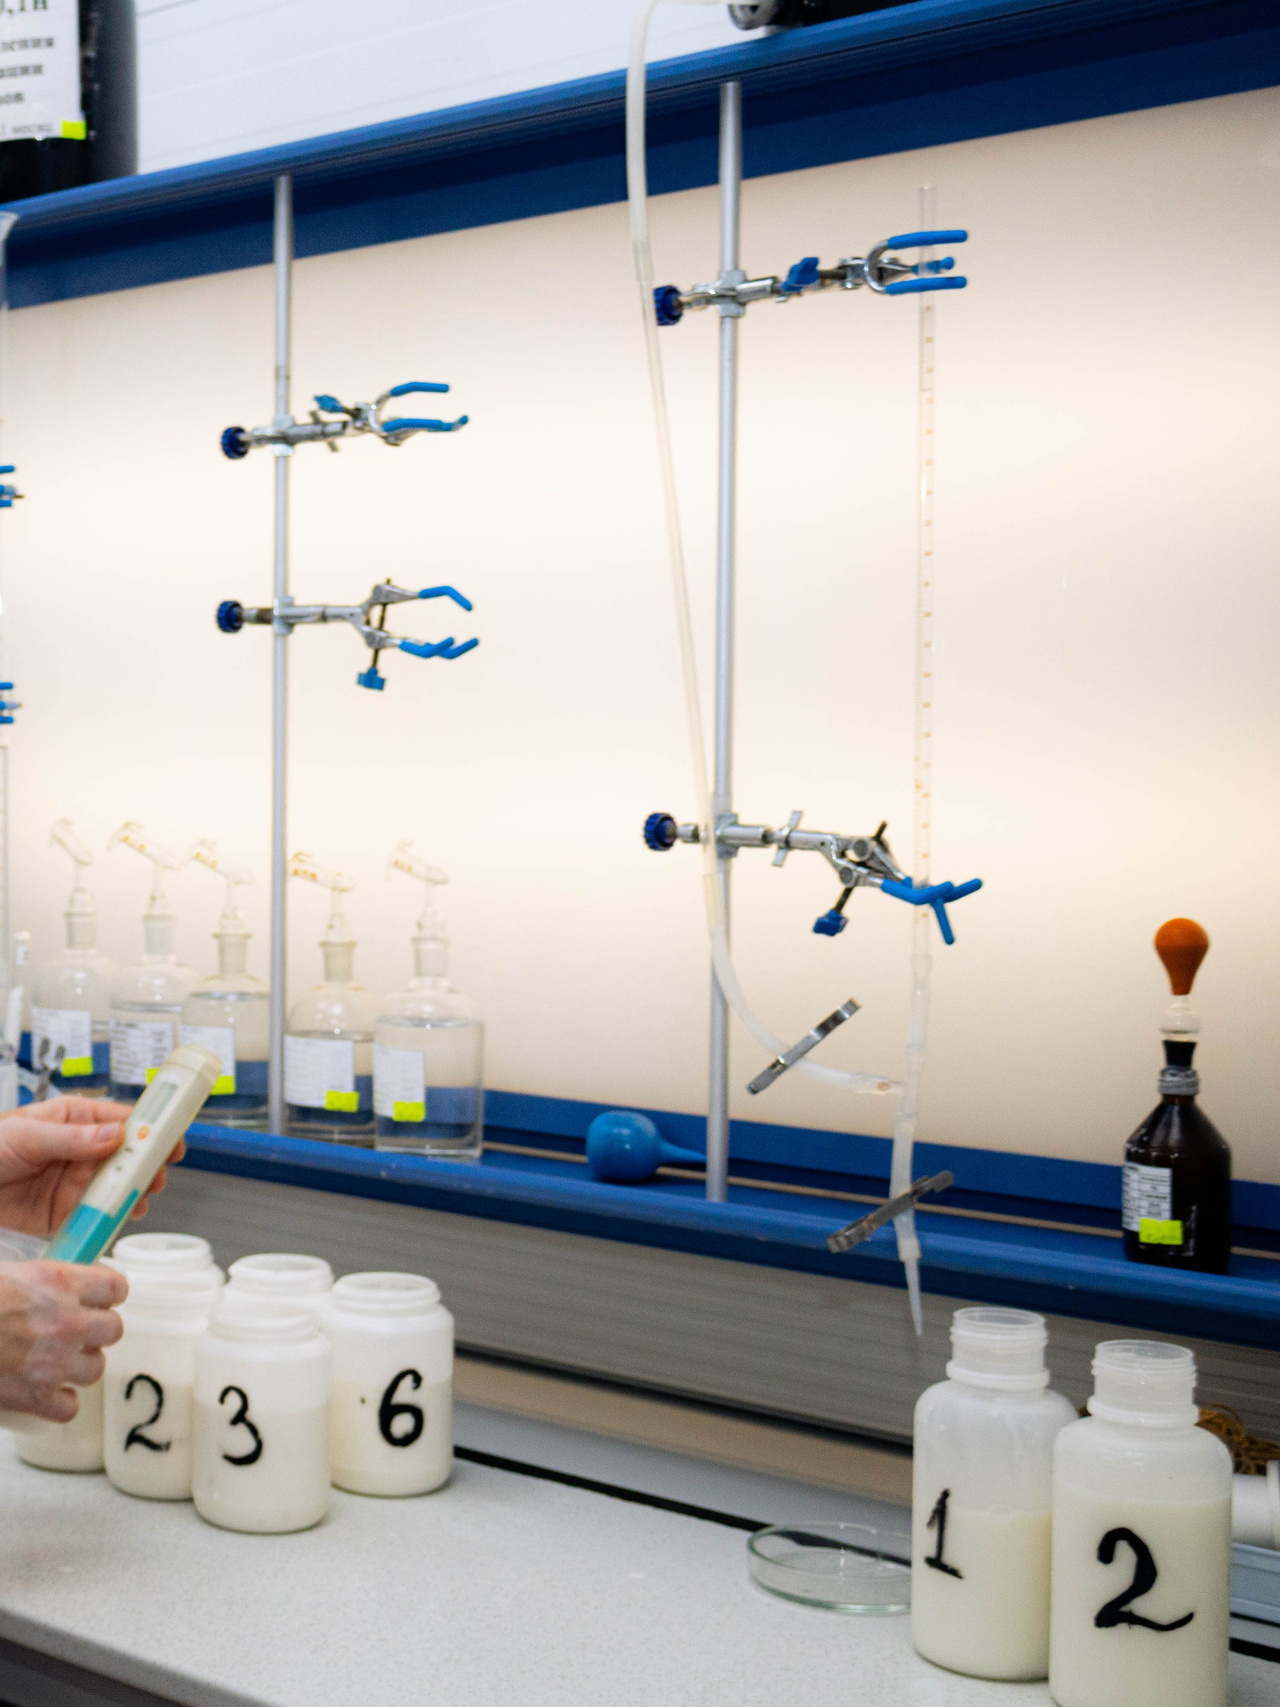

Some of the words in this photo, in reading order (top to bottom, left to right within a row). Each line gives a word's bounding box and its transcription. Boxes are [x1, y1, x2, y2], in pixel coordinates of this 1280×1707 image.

[123, 1373, 172, 1453] 2
[218, 1385, 264, 1467] 3
[377, 1368, 425, 1449] 6
[924, 1488, 964, 1580] 1
[1093, 1526, 1196, 1634] 2
